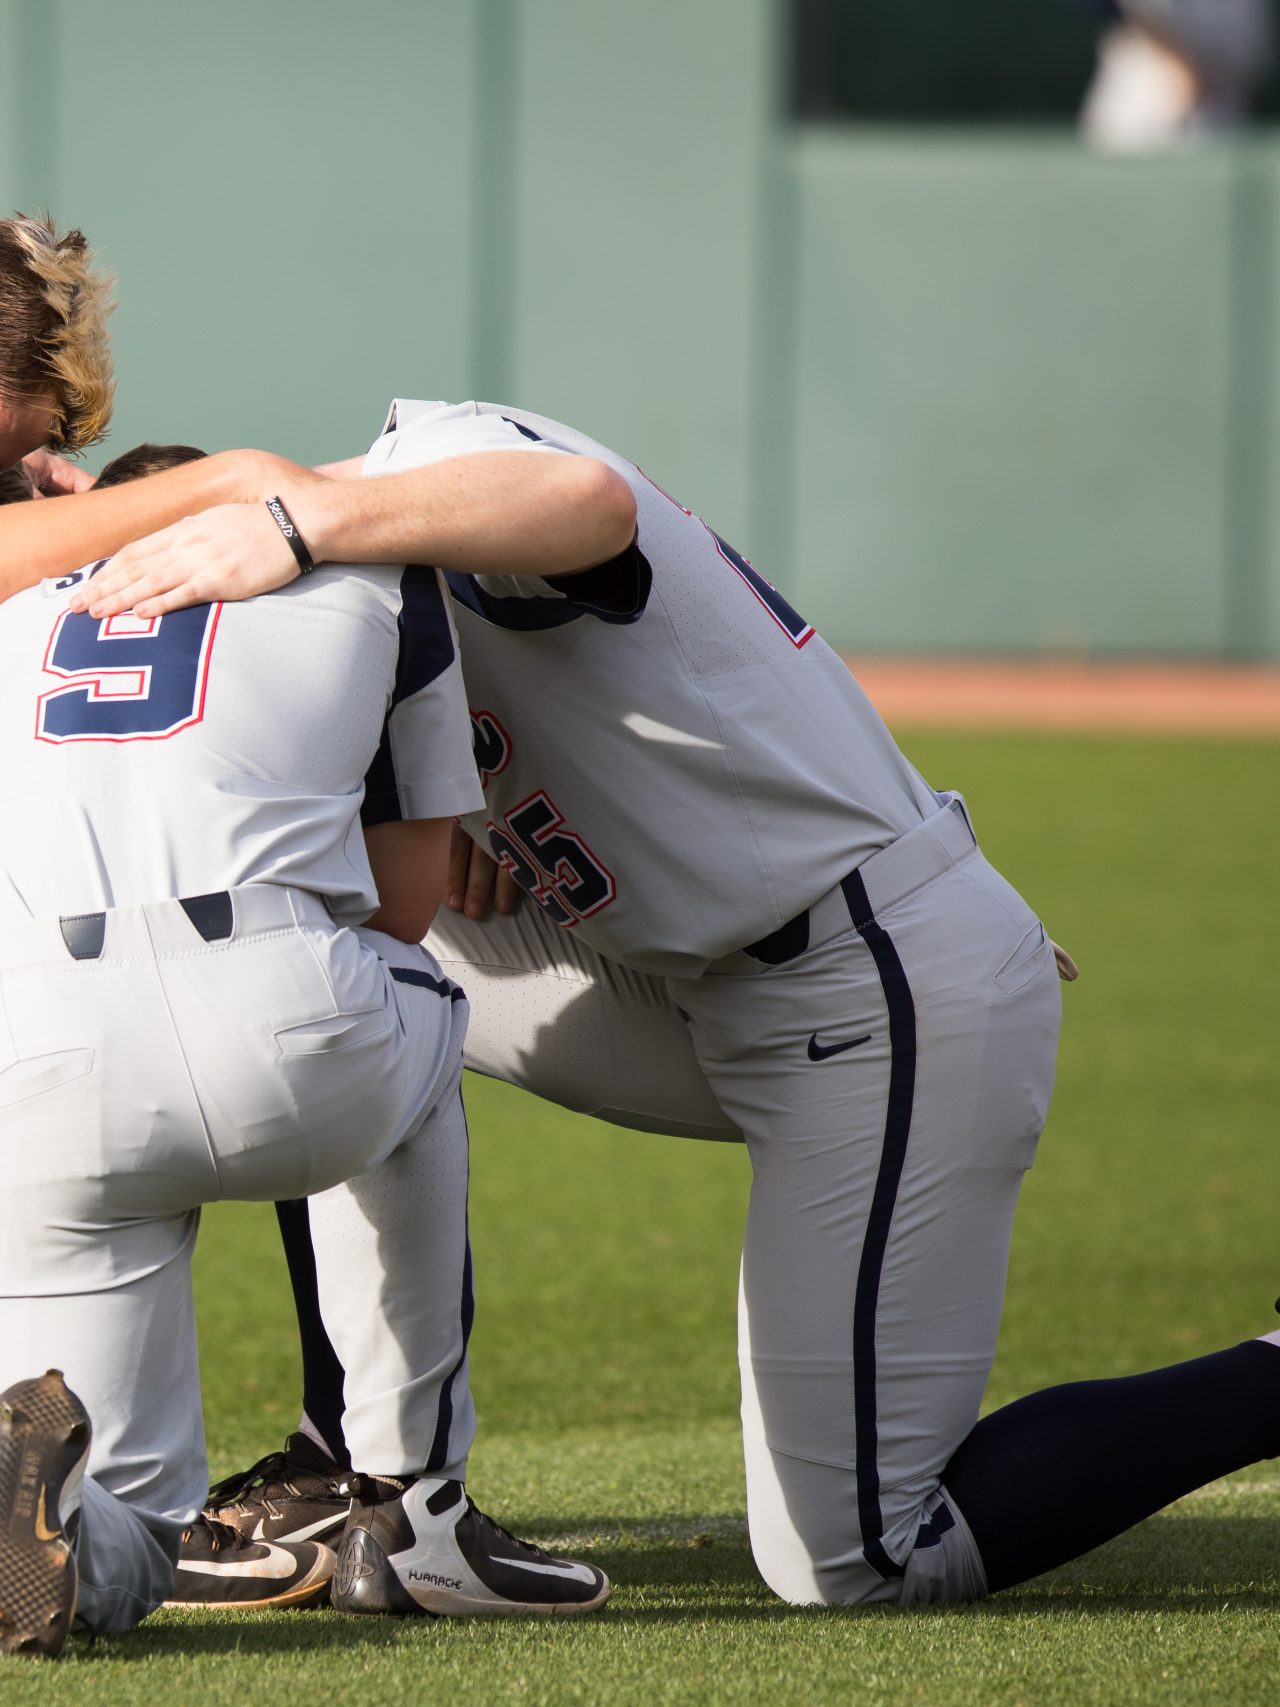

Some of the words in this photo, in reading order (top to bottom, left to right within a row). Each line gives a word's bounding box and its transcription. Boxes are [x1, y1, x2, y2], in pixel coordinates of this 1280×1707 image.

[35, 602, 224, 744] 9
[485, 789, 617, 928] 25
[408, 1568, 463, 1590] HUARACHE
